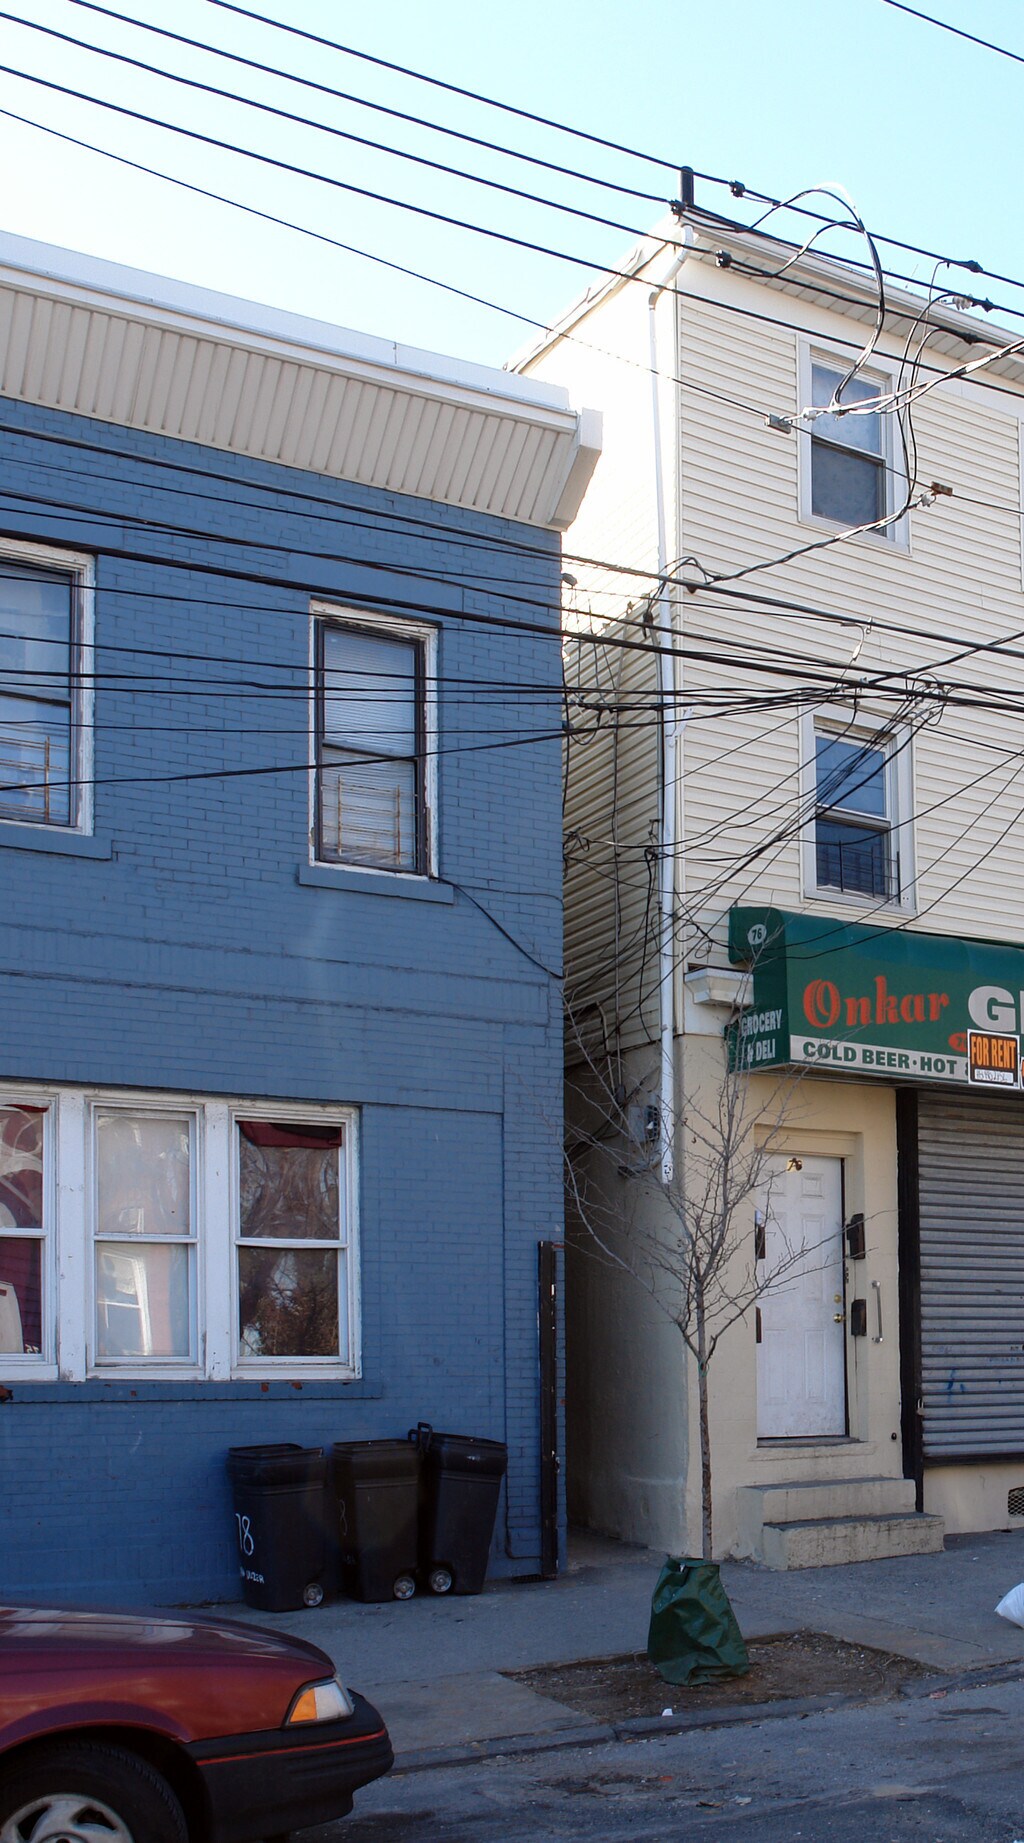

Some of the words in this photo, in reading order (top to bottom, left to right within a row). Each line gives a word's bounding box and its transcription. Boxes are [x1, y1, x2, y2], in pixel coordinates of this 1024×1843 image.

[752, 928, 762, 941] 76
[803, 976, 949, 1028] Onkar
[741, 1008, 782, 1036] GROCERY
[756, 1039, 776, 1061] DELI
[803, 1042, 857, 1062] COLD
[862, 1049, 910, 1069] BEER
[920, 1056, 957, 1075] HOT
[971, 1036, 989, 1066] FOR
[991, 1038, 1016, 1069] RENT
[235, 1513, 254, 1556] 18
